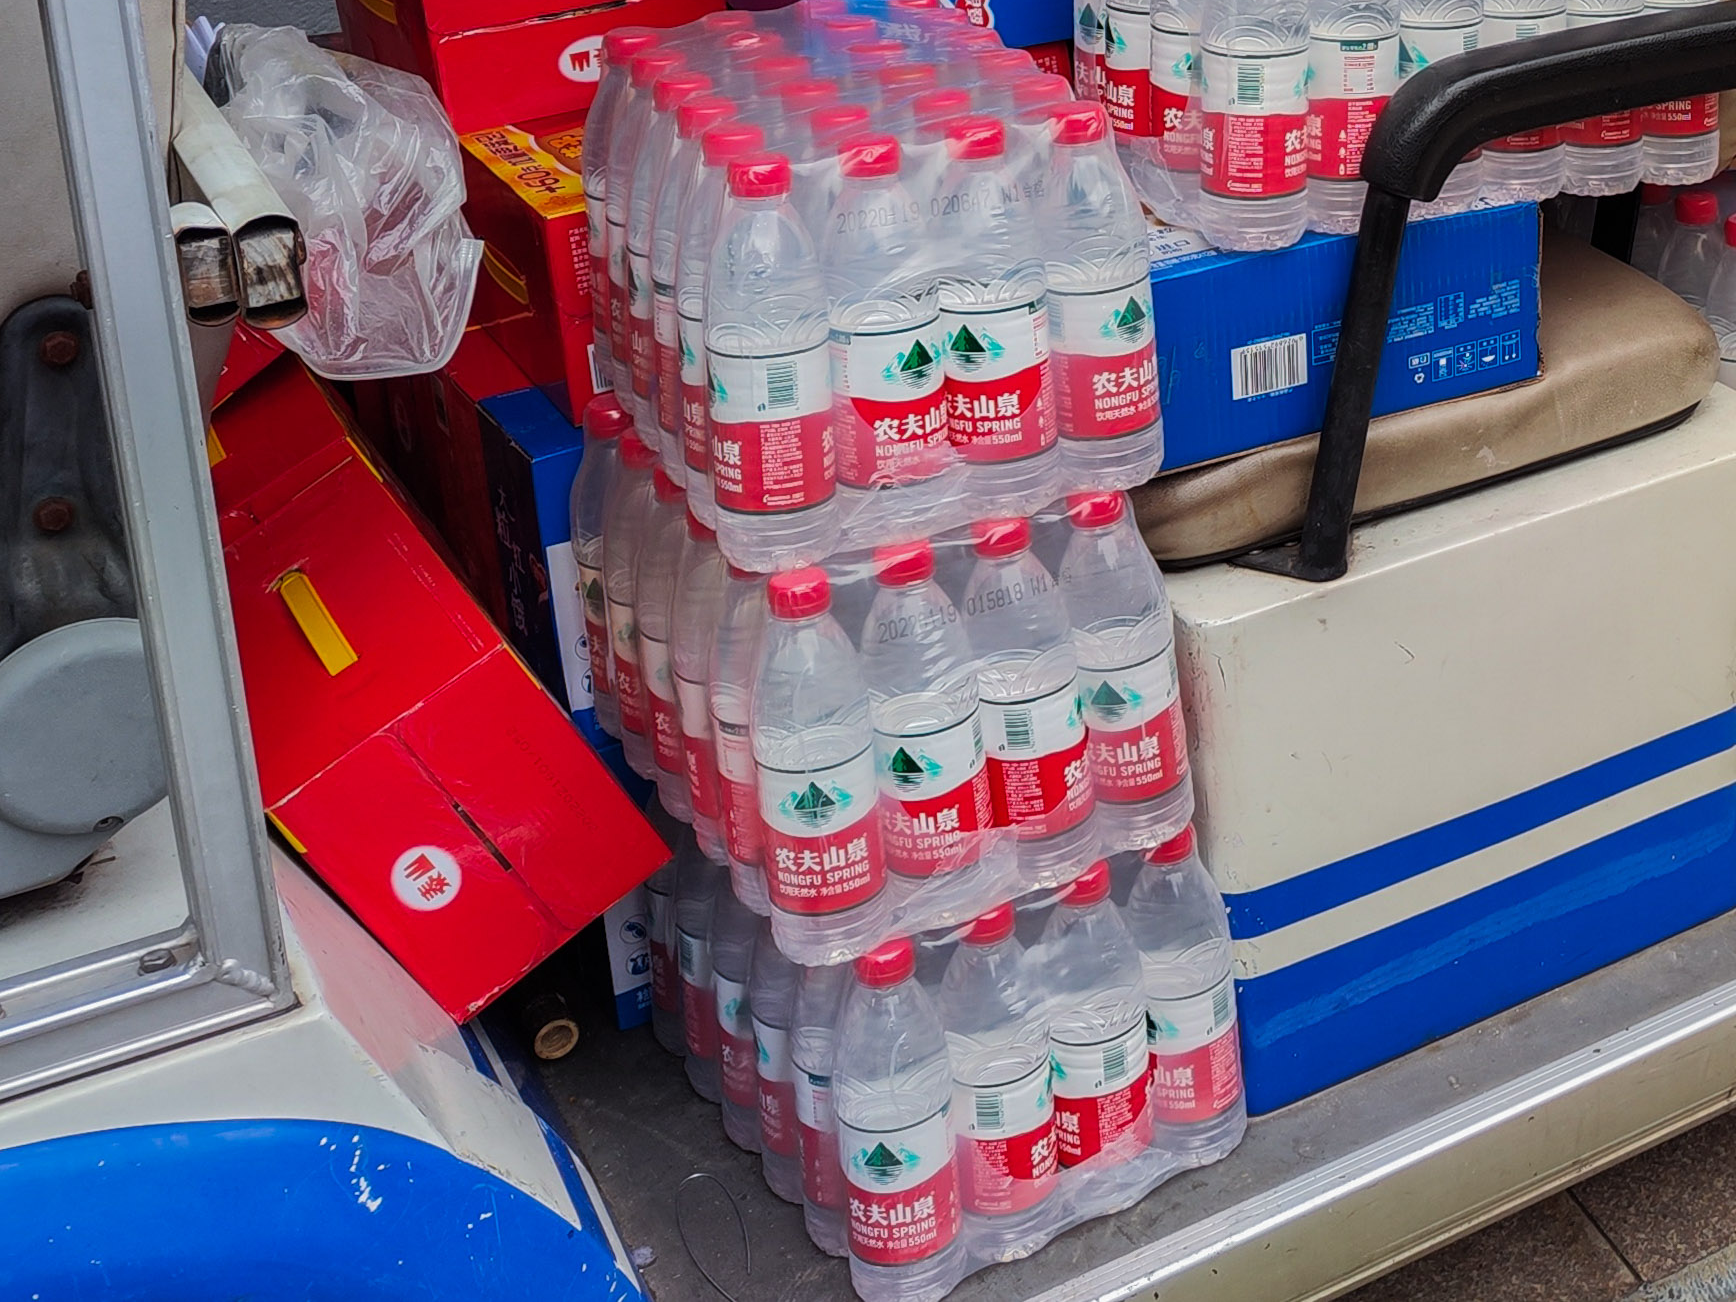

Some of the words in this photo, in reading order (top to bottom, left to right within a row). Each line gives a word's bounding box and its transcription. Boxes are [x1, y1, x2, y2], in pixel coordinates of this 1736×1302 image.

[1094, 393, 1140, 410] NONGFU
[976, 417, 1021, 433] SPRING
[712, 435, 742, 466] 山泉
[966, 582, 1023, 617] 015818
[1120, 757, 1162, 776] SPRING
[775, 836, 870, 872] 农夫山泉
[778, 870, 822, 886] NONGFU
[826, 859, 870, 884] SPRING
[849, 1194, 936, 1226] 农夫山泉
[892, 1217, 936, 1238] SPRING
